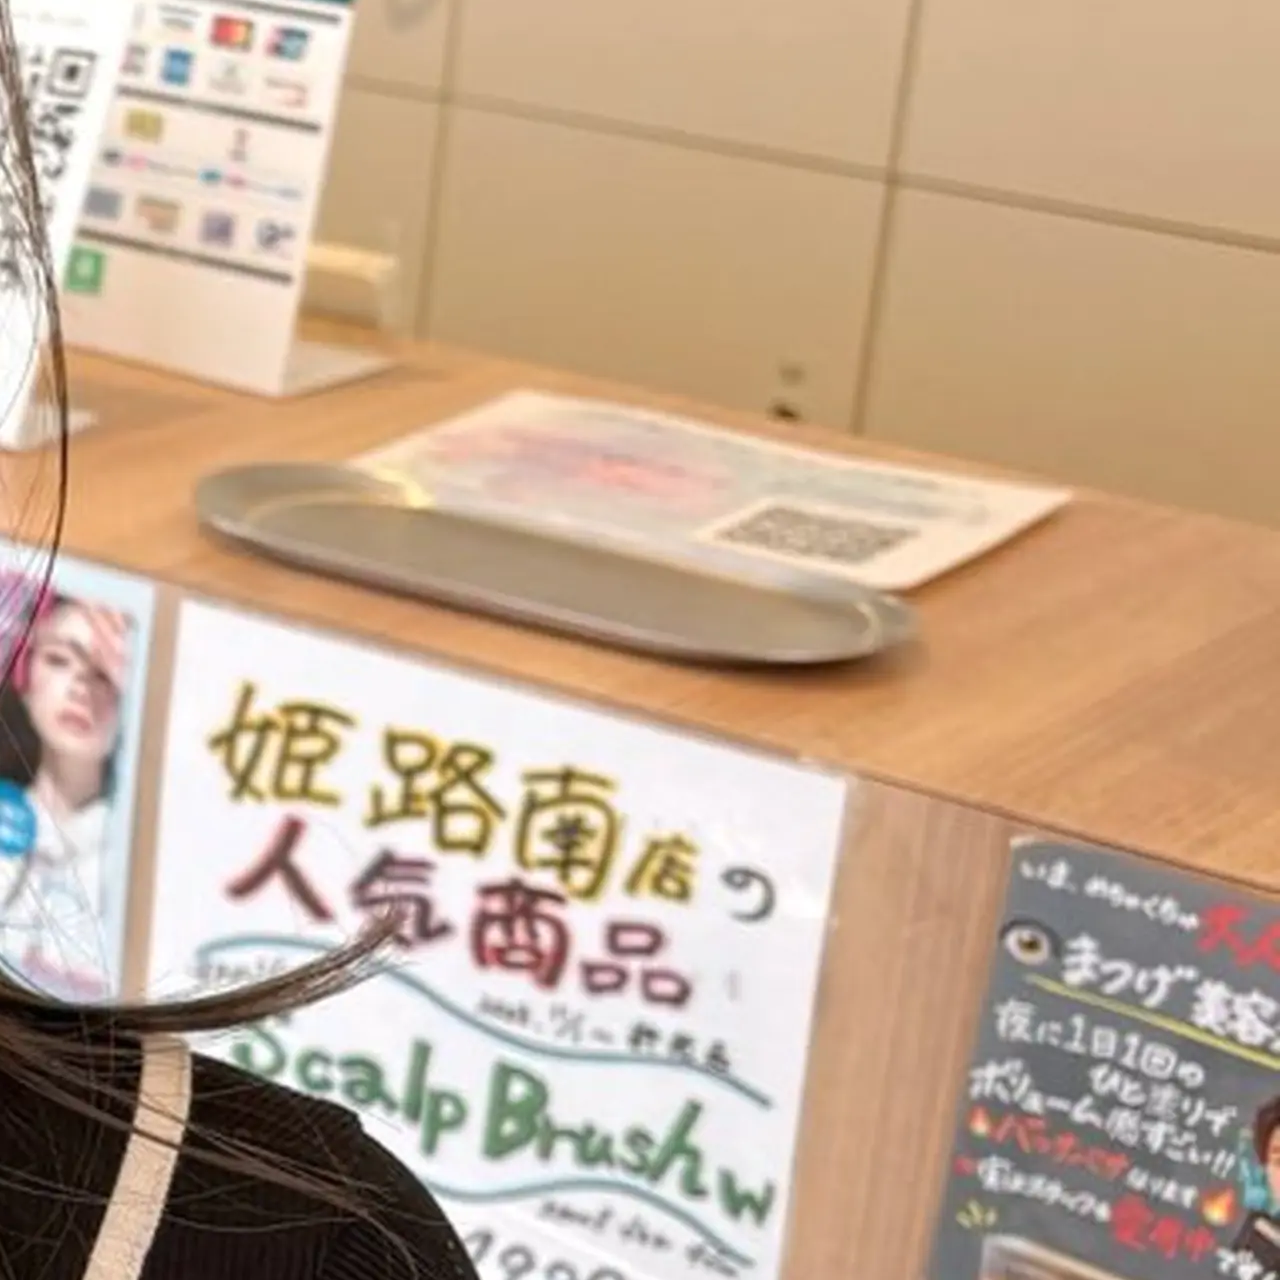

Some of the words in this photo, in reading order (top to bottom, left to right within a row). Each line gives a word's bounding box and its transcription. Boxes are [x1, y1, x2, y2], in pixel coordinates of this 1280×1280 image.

[206, 681, 778, 923] 姫路南店の
[226, 814, 697, 1010] 人気商品
[1062, 931, 1280, 1055] まつげ美容
[481, 1056, 710, 1200] Brush
